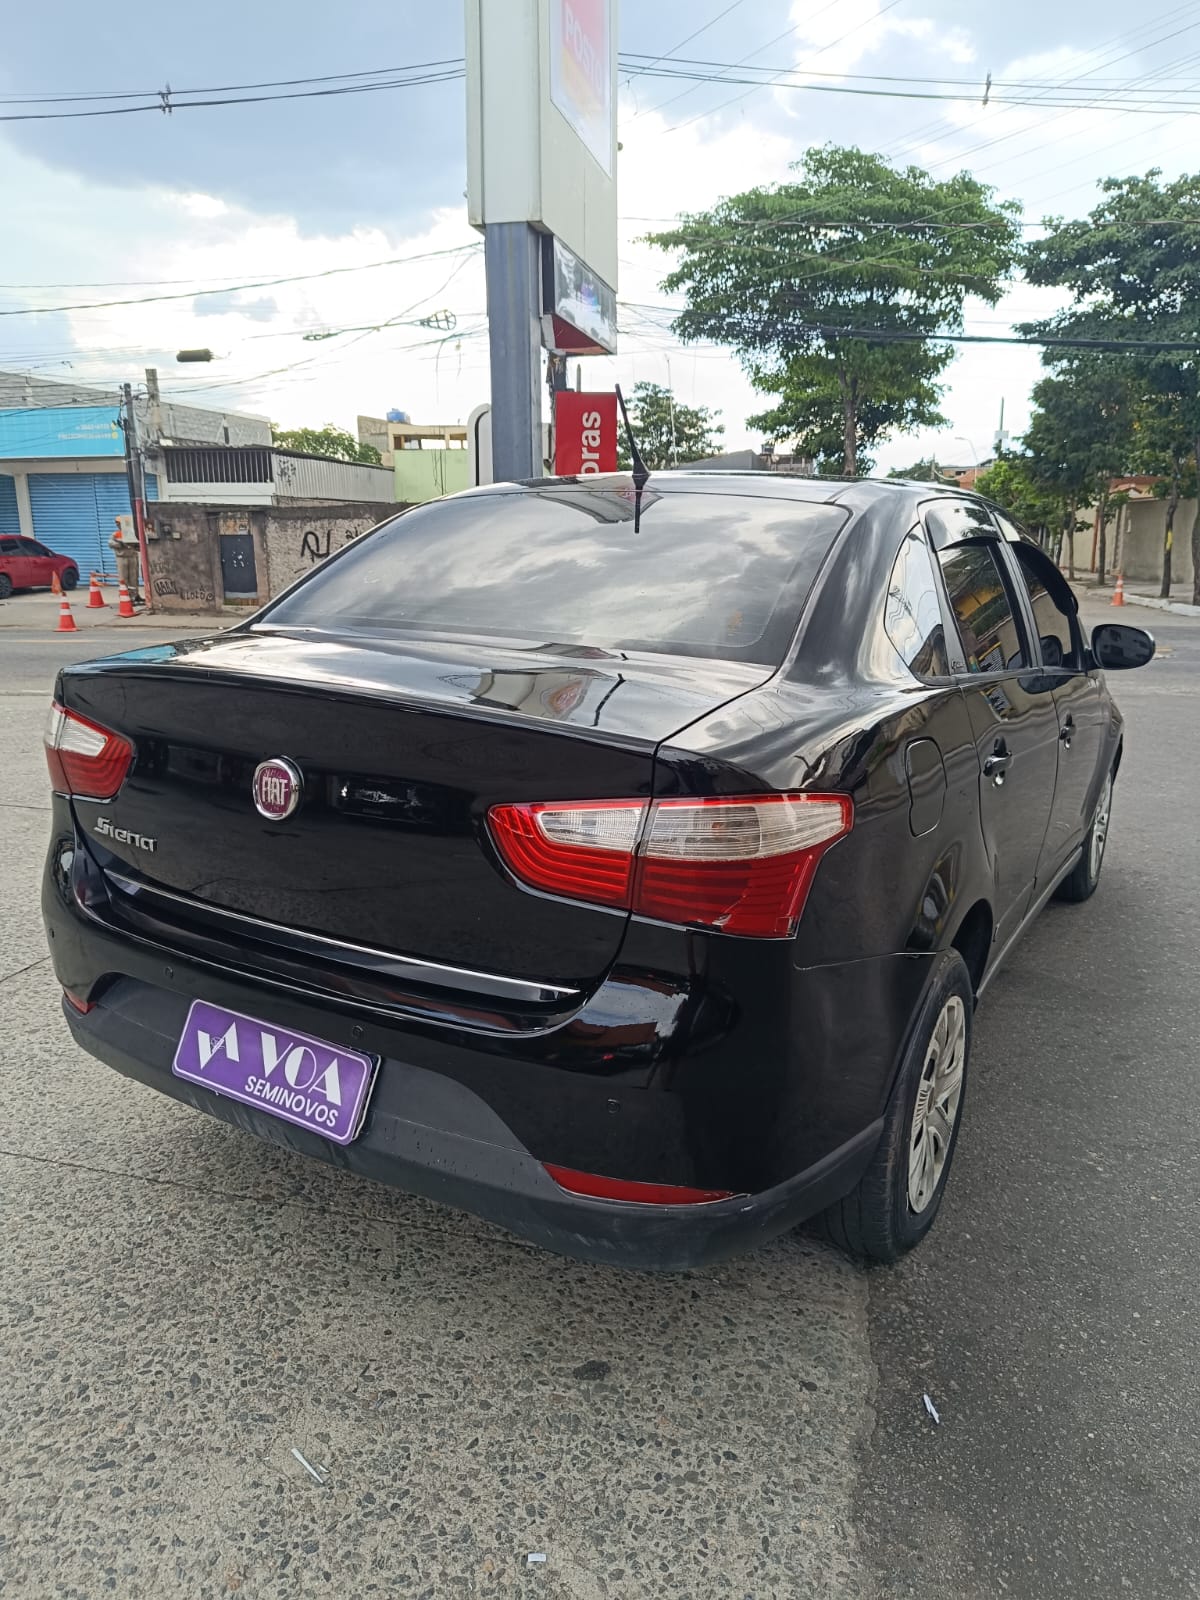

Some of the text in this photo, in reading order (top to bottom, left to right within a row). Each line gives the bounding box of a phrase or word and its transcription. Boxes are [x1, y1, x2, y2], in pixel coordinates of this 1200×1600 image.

[261, 775, 289, 806] FIAT
[93, 816, 154, 853] Siena
[260, 1031, 342, 1106] VOA
[244, 1075, 339, 1127] SEMINOVOS
